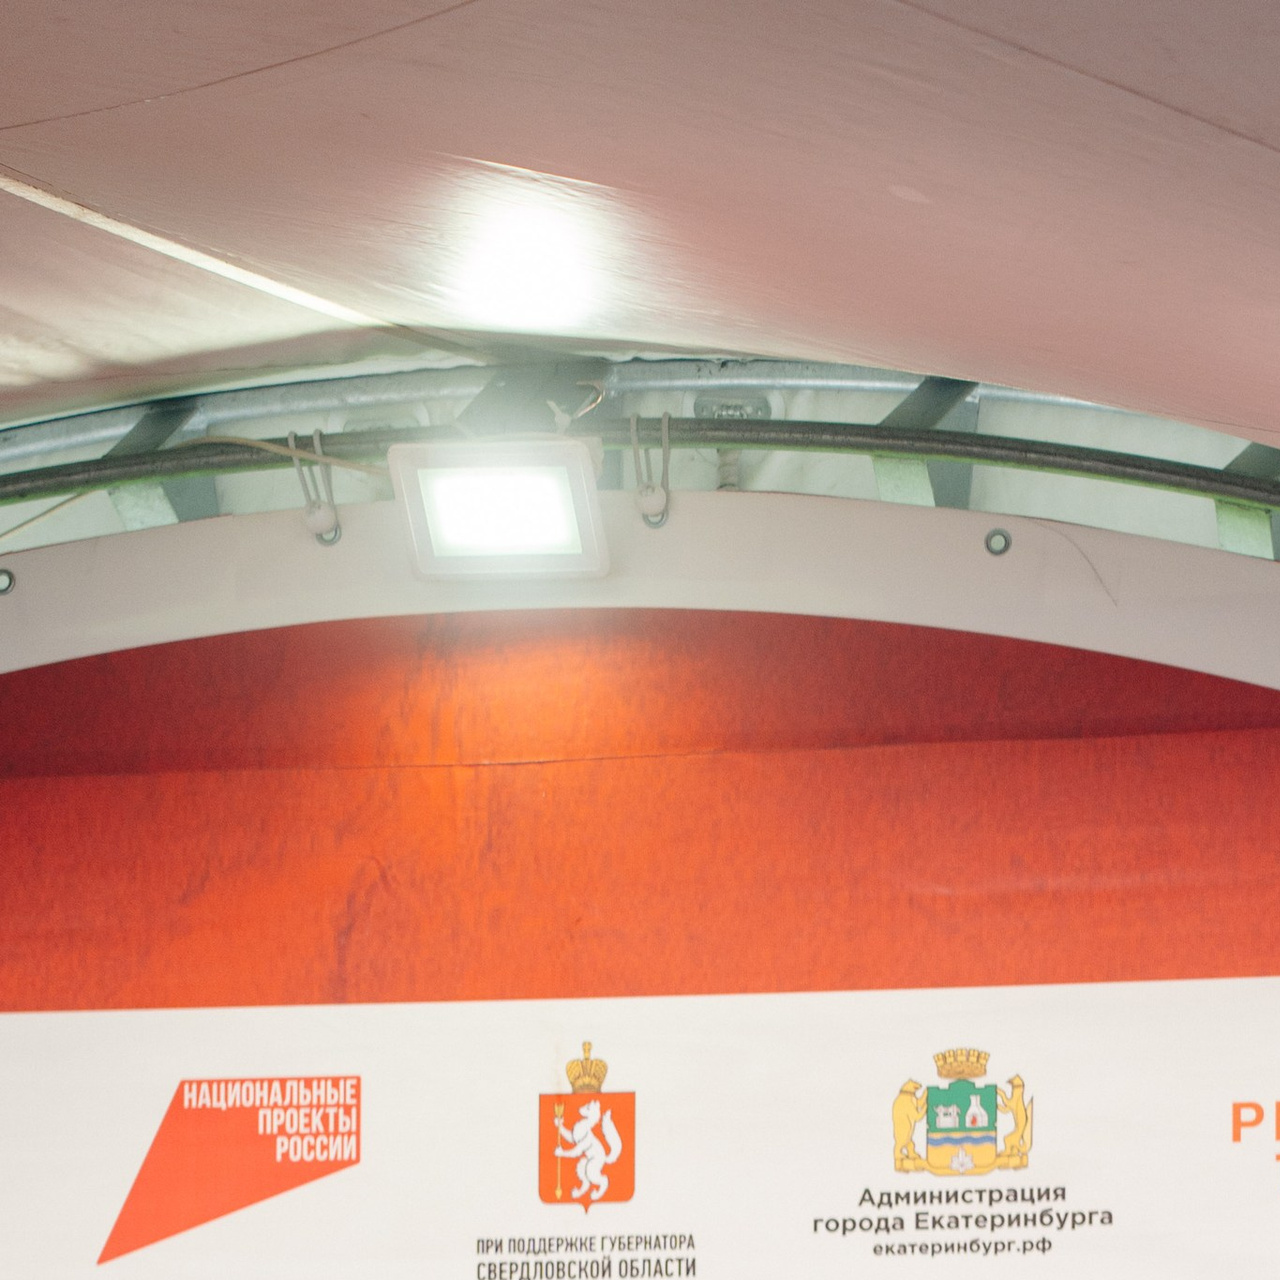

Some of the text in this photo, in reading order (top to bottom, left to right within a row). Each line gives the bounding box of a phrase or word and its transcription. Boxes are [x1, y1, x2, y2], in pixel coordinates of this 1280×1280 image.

[183, 1078, 357, 1111] НАЦИОНАЛЬНЫЕ
[258, 1106, 357, 1135] ПРОЕКТЫ
[275, 1134, 357, 1162] РОССИИ
[858, 1186, 1067, 1208] Администрация
[813, 1208, 1114, 1235] города Екатеринбурга
[476, 1234, 696, 1256] ПРИ ПОДДЕРЖКЕ ГУБЕРНАТОРА
[872, 1237, 1053, 1257] екатеринбург.рф
[618, 1258, 697, 1279] ОБЛАСТИ
